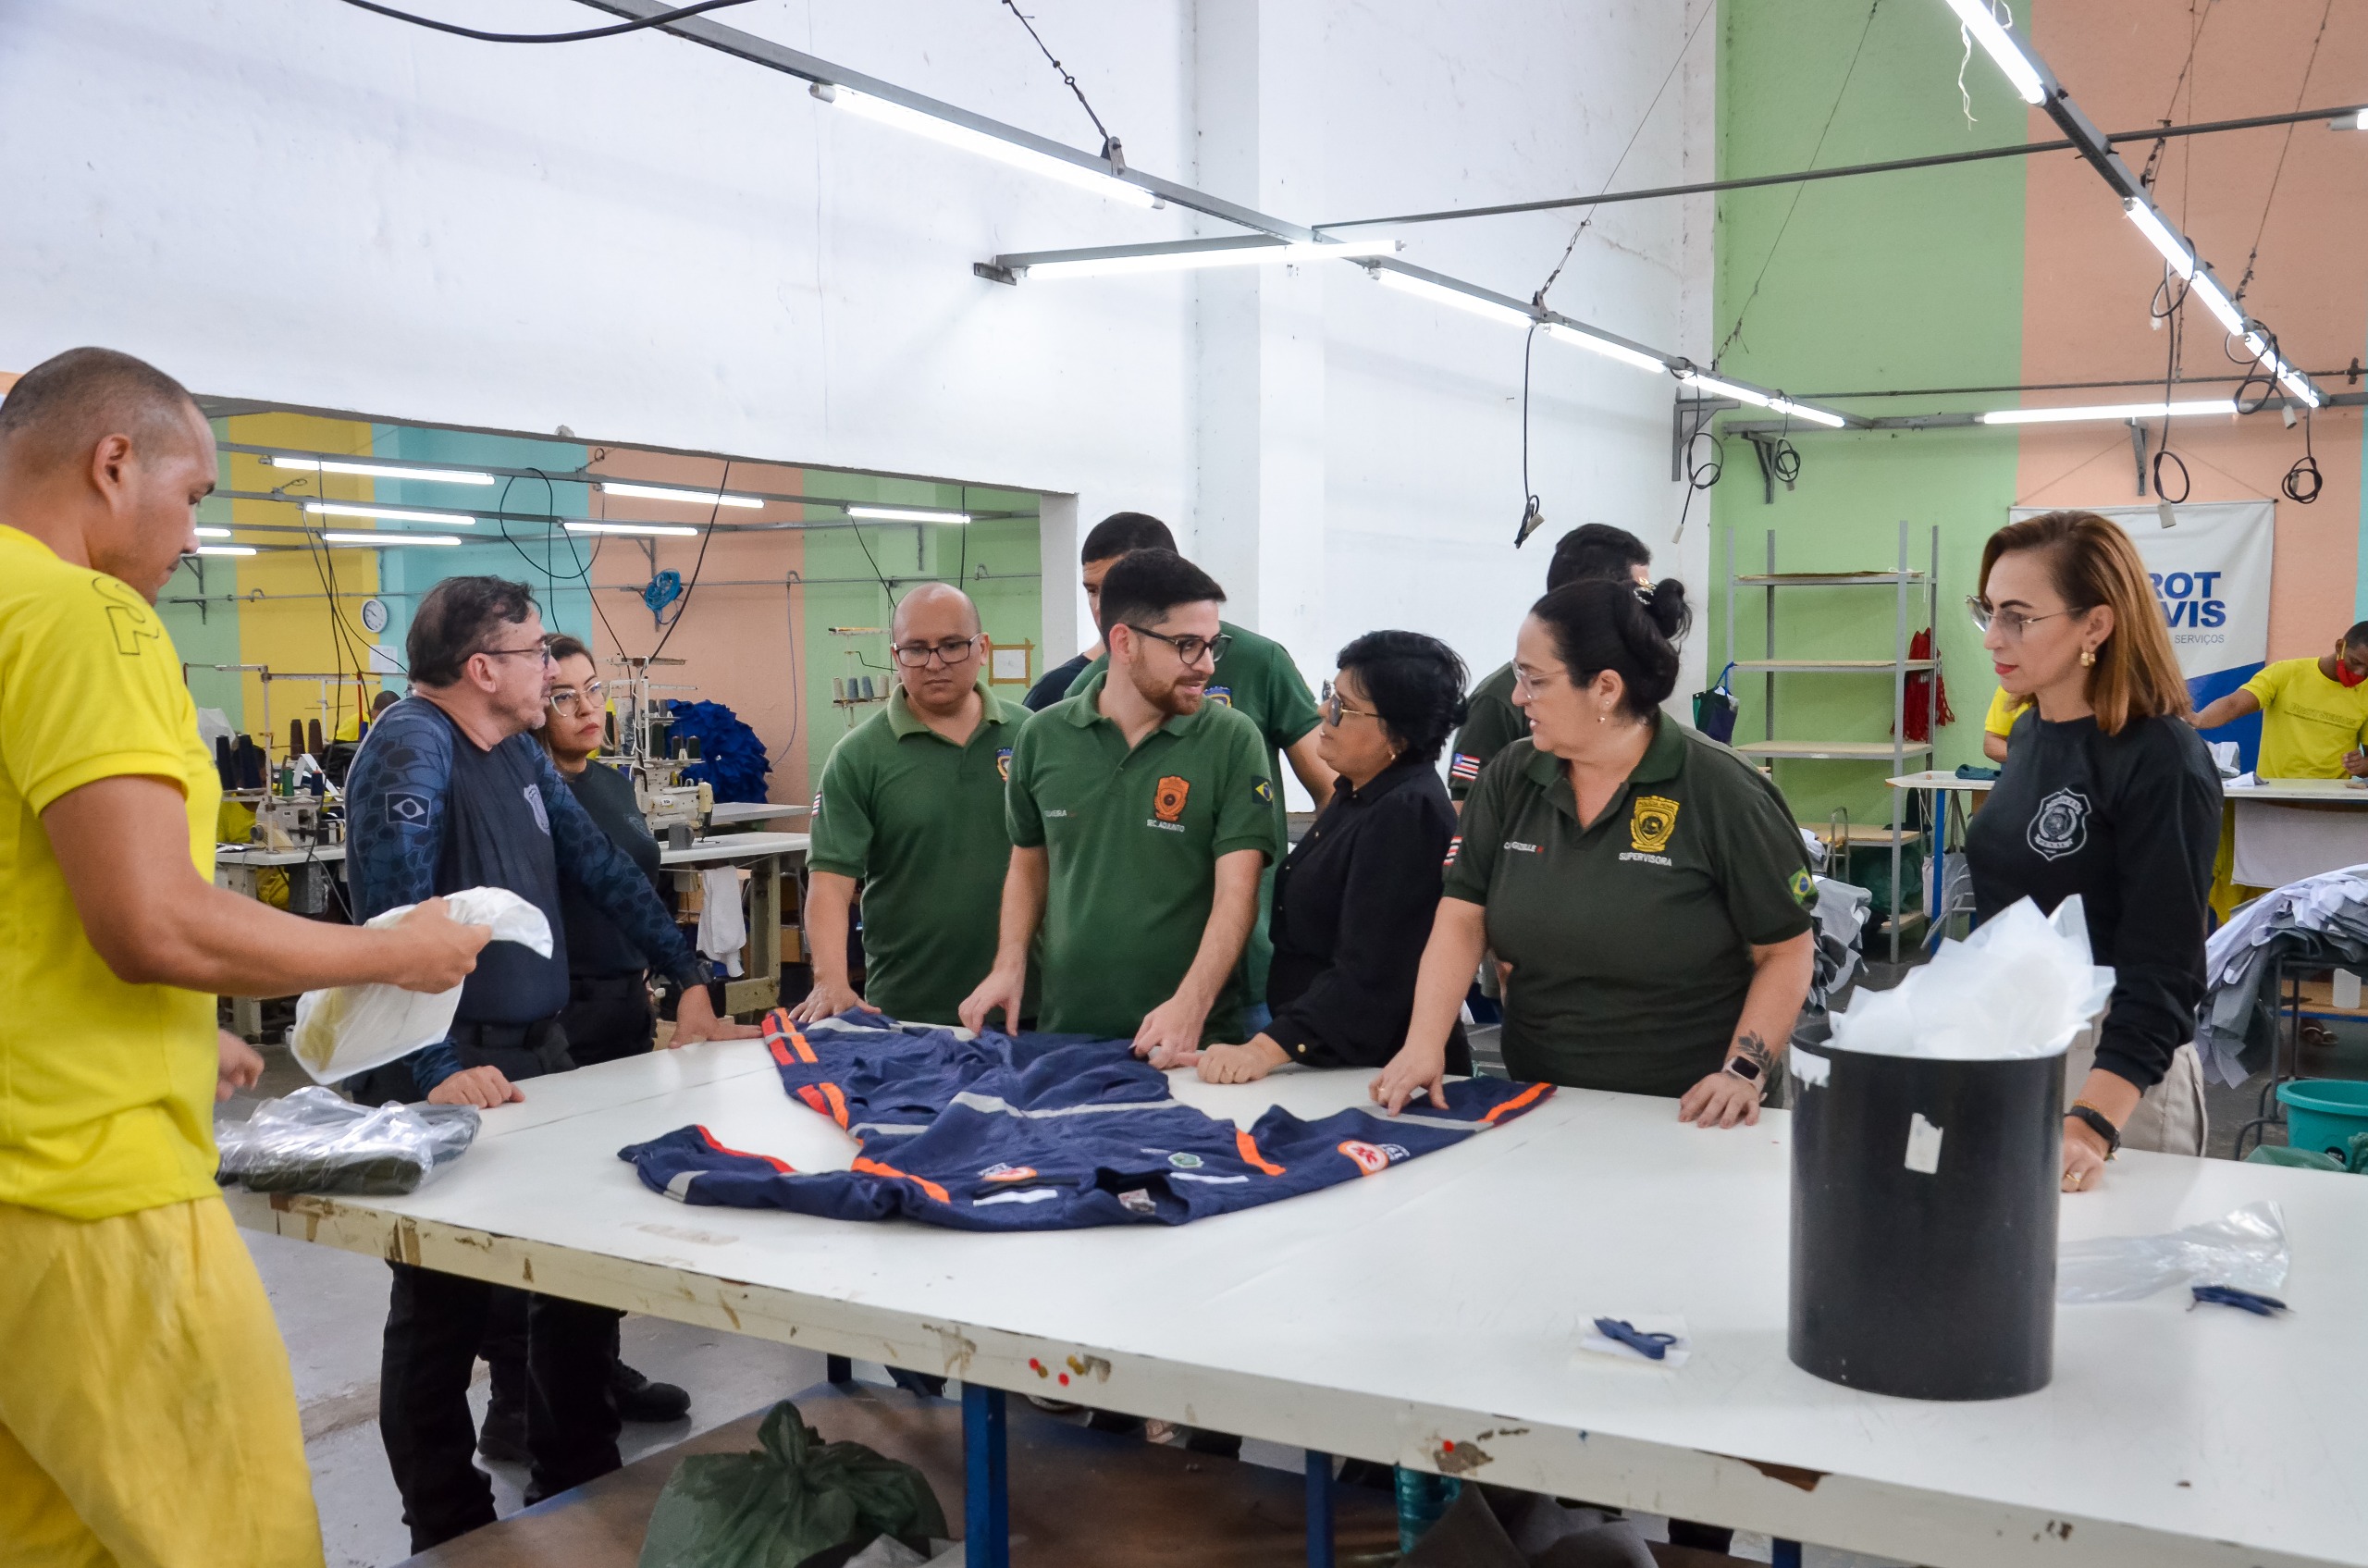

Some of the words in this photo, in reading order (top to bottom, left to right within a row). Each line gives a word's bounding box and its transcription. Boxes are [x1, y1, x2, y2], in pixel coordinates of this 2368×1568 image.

[2148, 572, 2222, 599] ROT
[2160, 599, 2226, 628] VIS
[2174, 634, 2226, 646] SERVIÇOS
[1618, 851, 1672, 867] SUPERVISORA
